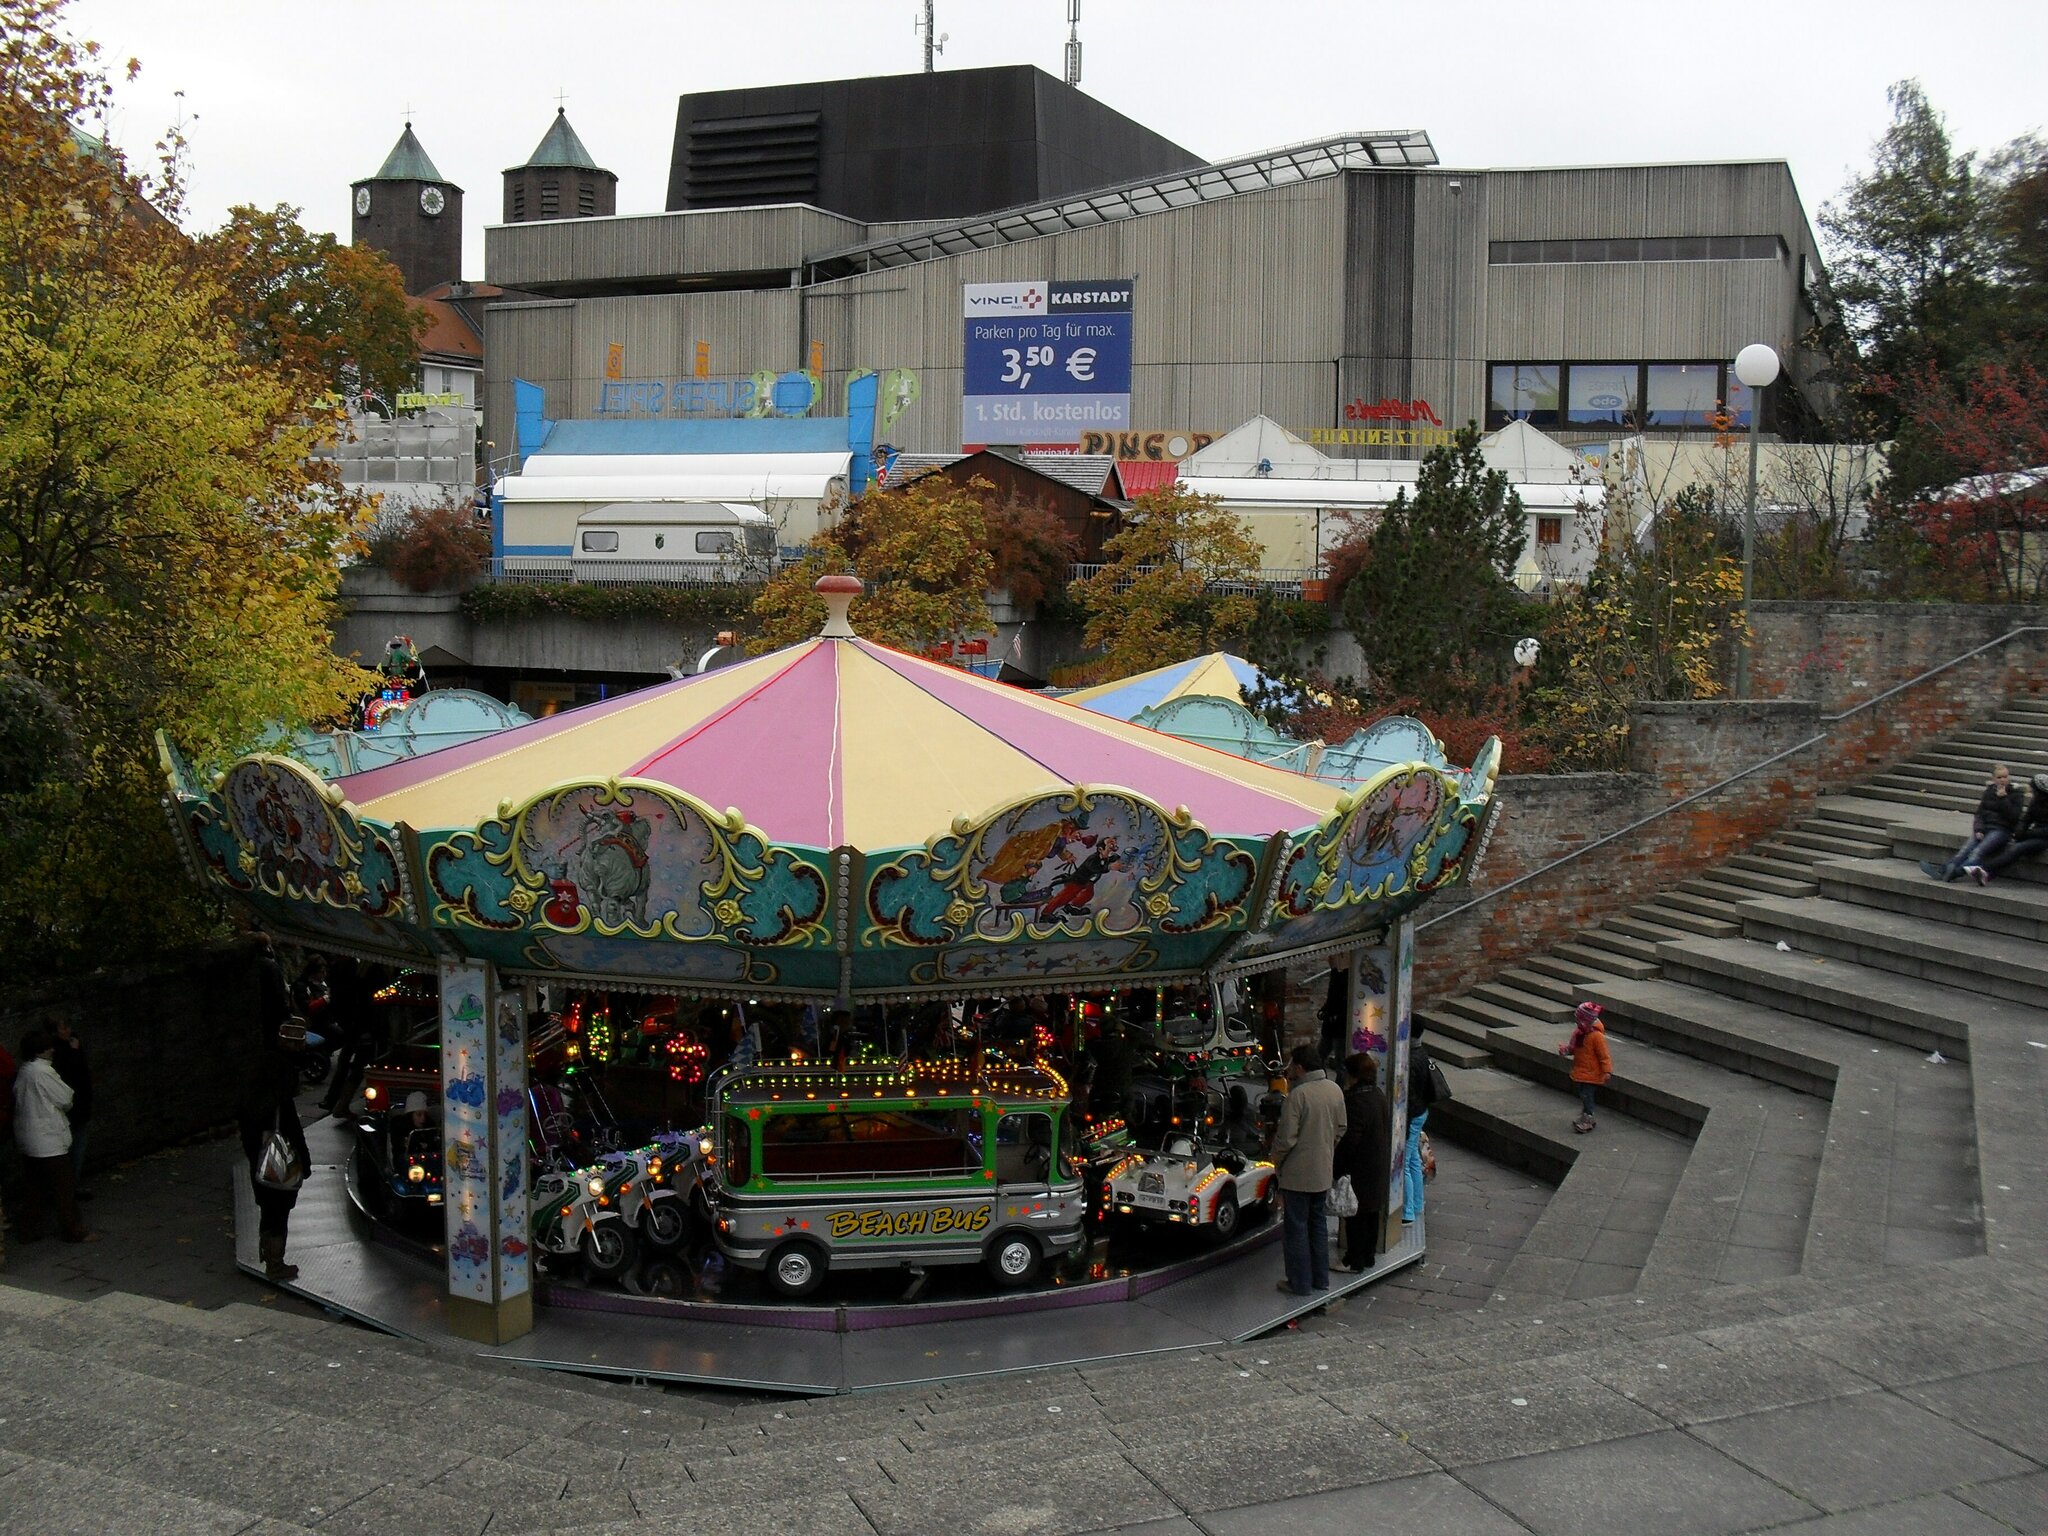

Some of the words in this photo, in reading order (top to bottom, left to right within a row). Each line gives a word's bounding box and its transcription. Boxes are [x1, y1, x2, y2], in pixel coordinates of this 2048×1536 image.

[970, 295, 1018, 305] VINCI
[1051, 291, 1130, 305] KARSTADT
[975, 325, 1014, 339] Parken
[1018, 327, 1037, 341] pro
[1042, 324, 1061, 341] Tag
[1066, 322, 1081, 337] für
[1086, 325, 1115, 337] max.
[1001, 346, 1054, 389] 3,50
[1065, 347, 1097, 381] €
[976, 404, 988, 421] 1.
[993, 401, 1026, 421] Std.
[1033, 400, 1121, 421] kostenlos
[825, 1209, 928, 1238] BEACH
[931, 1204, 992, 1234] BUS
